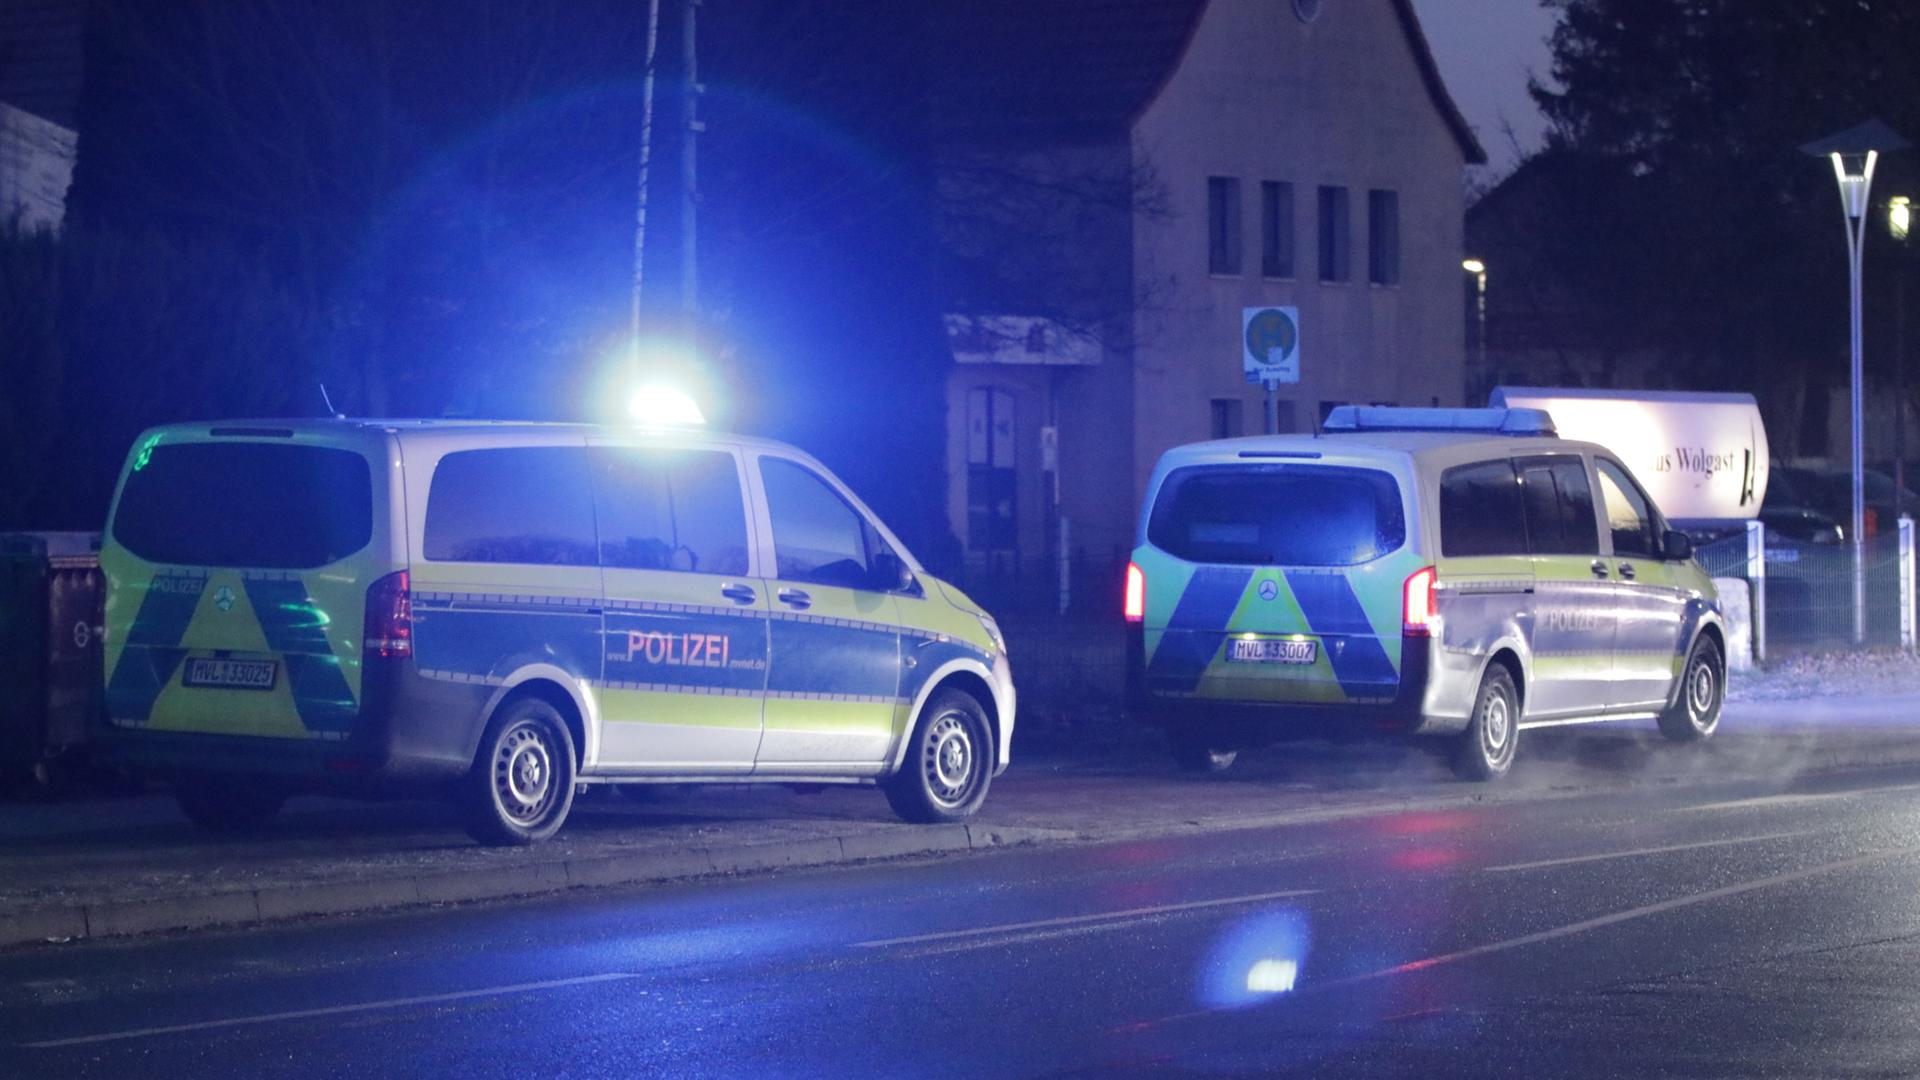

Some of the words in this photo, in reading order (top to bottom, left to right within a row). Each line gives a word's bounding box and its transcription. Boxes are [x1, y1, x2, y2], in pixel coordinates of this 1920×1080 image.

[1676, 447, 1734, 480] Wolgast
[153, 578, 203, 593] POLIZEI
[1550, 609, 1598, 632] POLIZEI
[627, 630, 729, 668] POLIZEI
[1236, 642, 1262, 658] MVL
[1271, 641, 1313, 659] 33007
[194, 661, 219, 680] MVL
[229, 663, 271, 683] 33025
